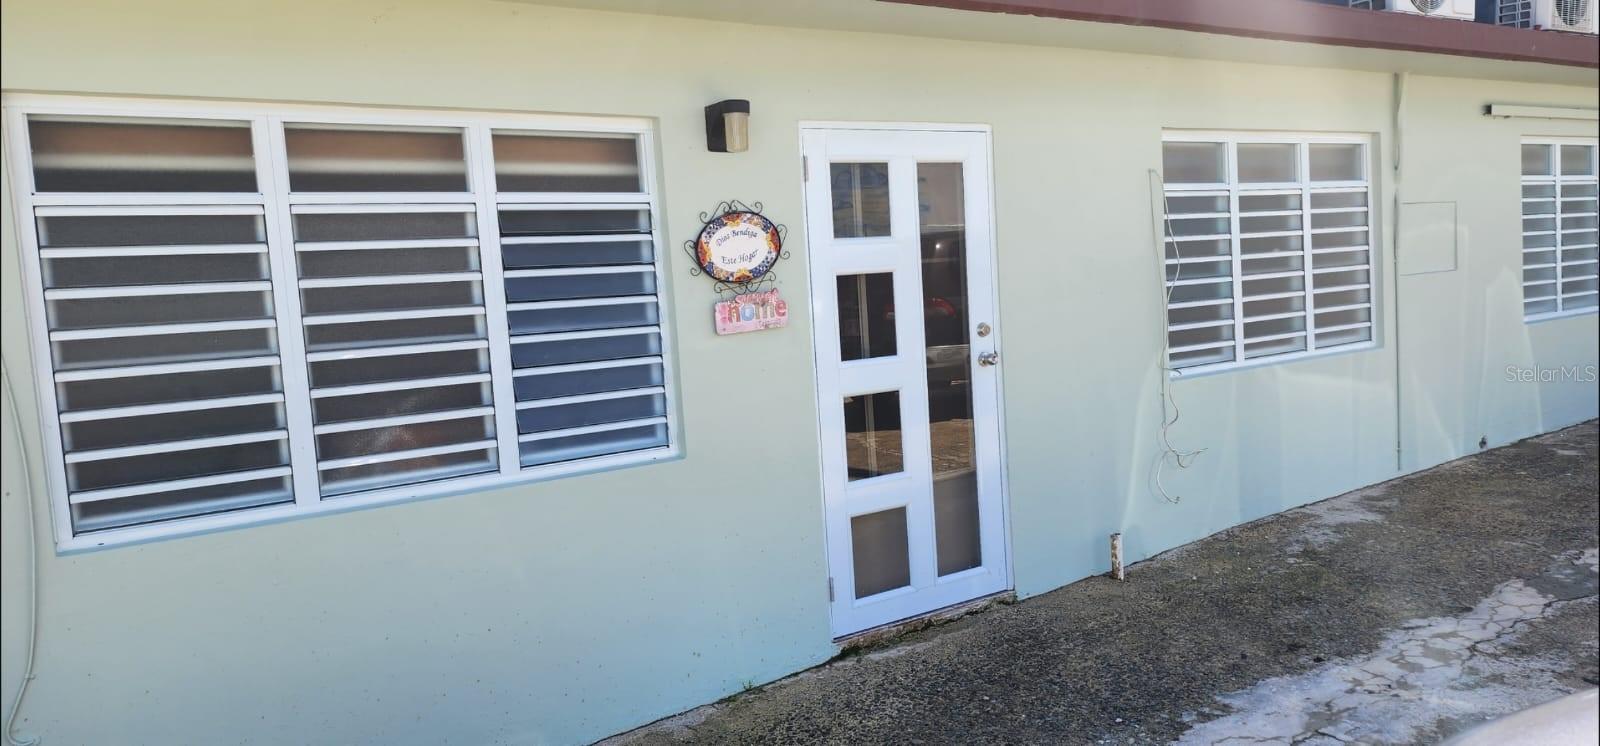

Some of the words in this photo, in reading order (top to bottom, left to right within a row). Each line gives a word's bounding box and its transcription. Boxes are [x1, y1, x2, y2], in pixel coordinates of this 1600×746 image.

[731, 228, 758, 238] Bendiga
[721, 256, 736, 264] Este
[738, 249, 759, 262] Hogar
